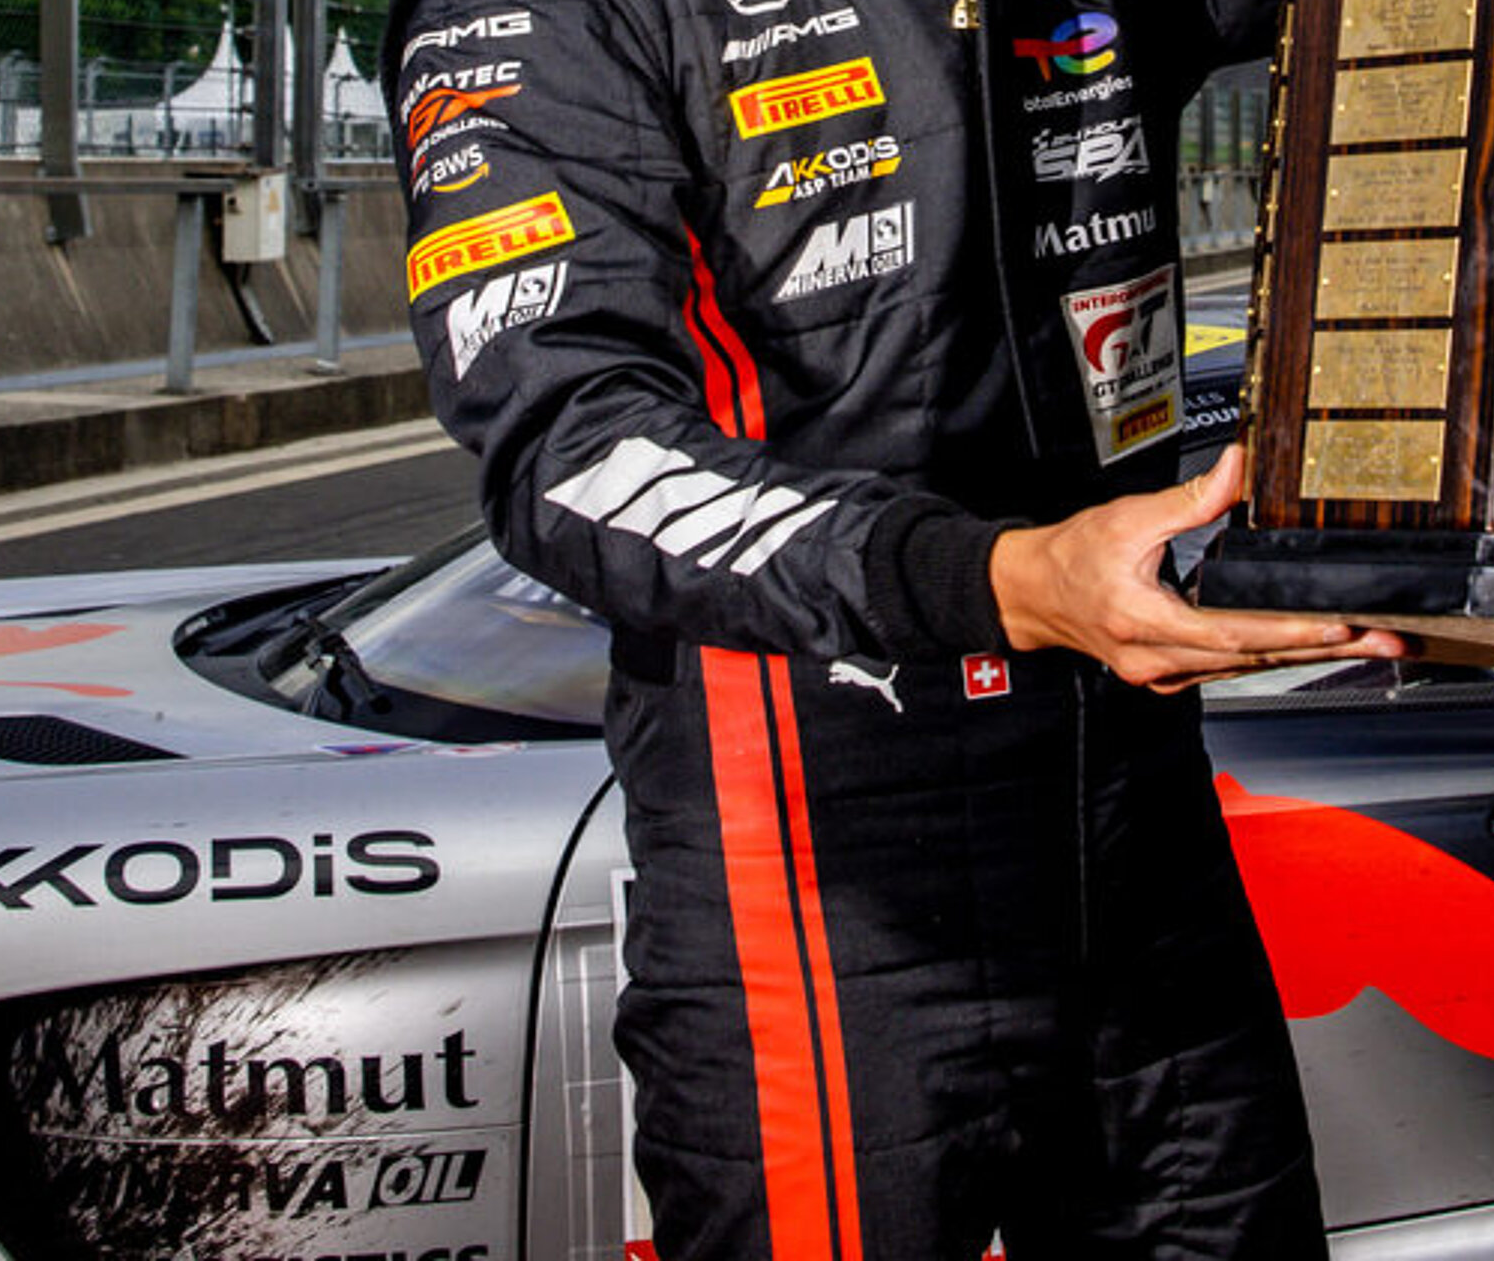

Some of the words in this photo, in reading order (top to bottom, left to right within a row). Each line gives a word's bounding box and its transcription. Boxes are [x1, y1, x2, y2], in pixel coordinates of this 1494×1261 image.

[401, 11, 533, 71] AMG
[739, 66, 878, 131] PIRELLI
[1024, 75, 1133, 112] otalEnergies
[431, 143, 484, 181] aws
[1034, 205, 1157, 259] Matmu
[35, 1028, 480, 1119] Matmut
[377, 1148, 483, 1207] OIL
